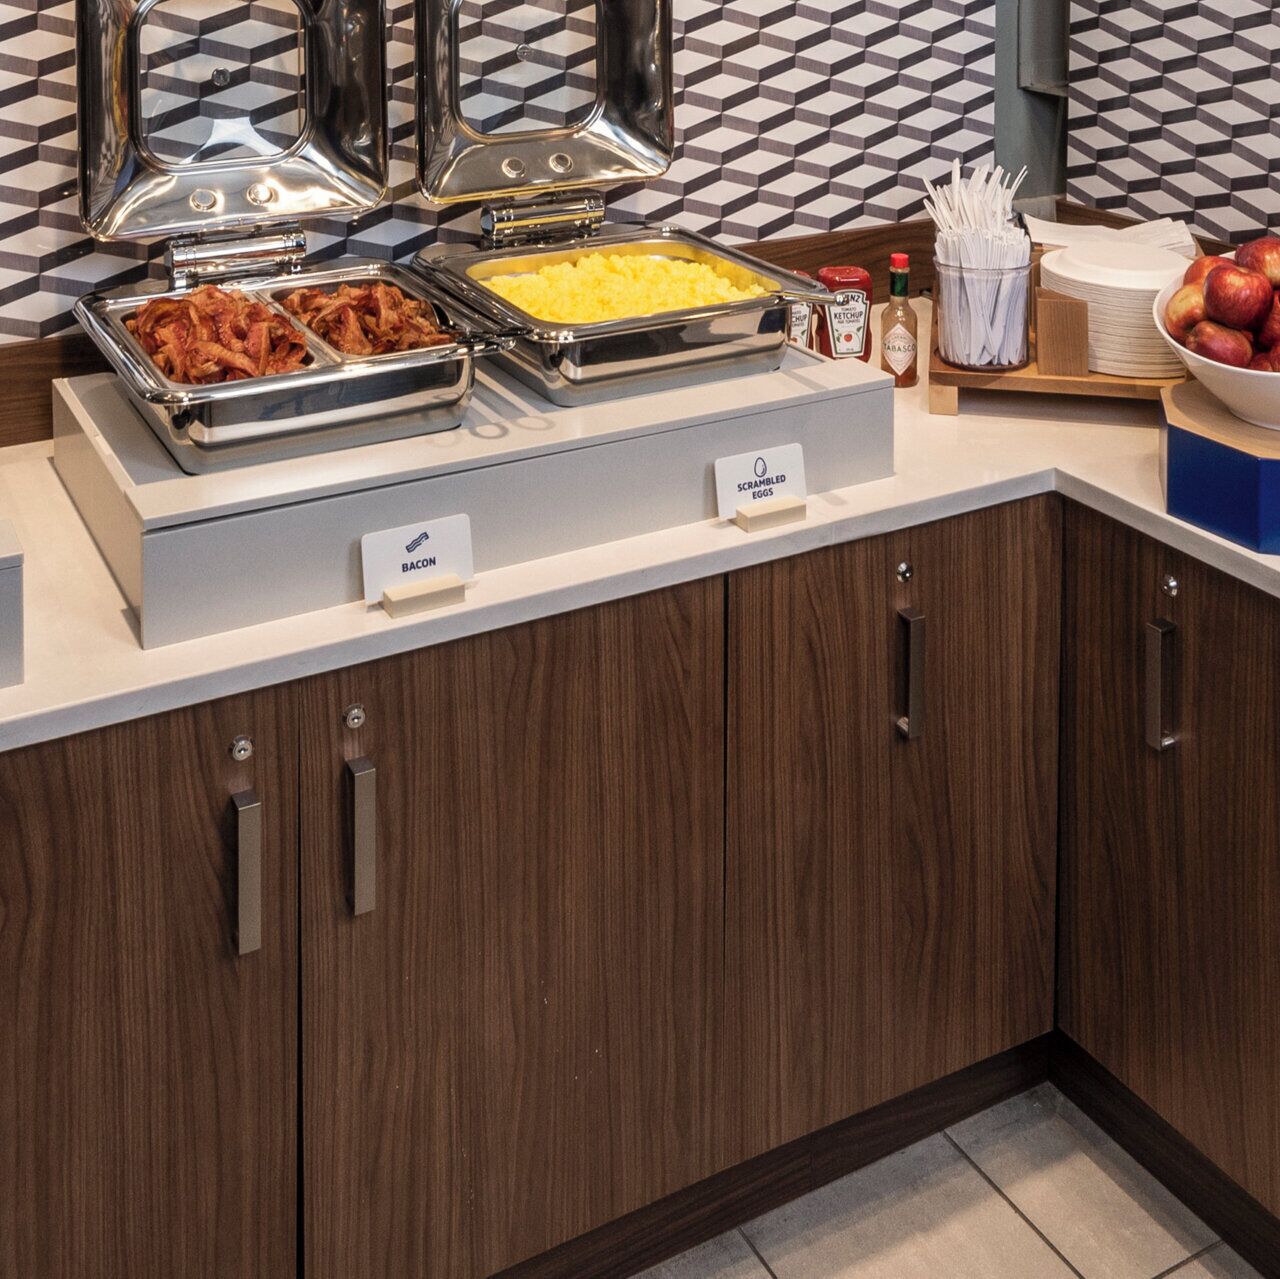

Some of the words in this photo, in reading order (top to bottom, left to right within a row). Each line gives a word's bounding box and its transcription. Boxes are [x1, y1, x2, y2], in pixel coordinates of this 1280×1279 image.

[833, 310, 864, 320] KETCHUP
[883, 343, 916, 353] TABASCO
[737, 474, 786, 492] SCRAMBLED
[752, 488, 774, 500] EGGS
[401, 556, 437, 573] BACON
